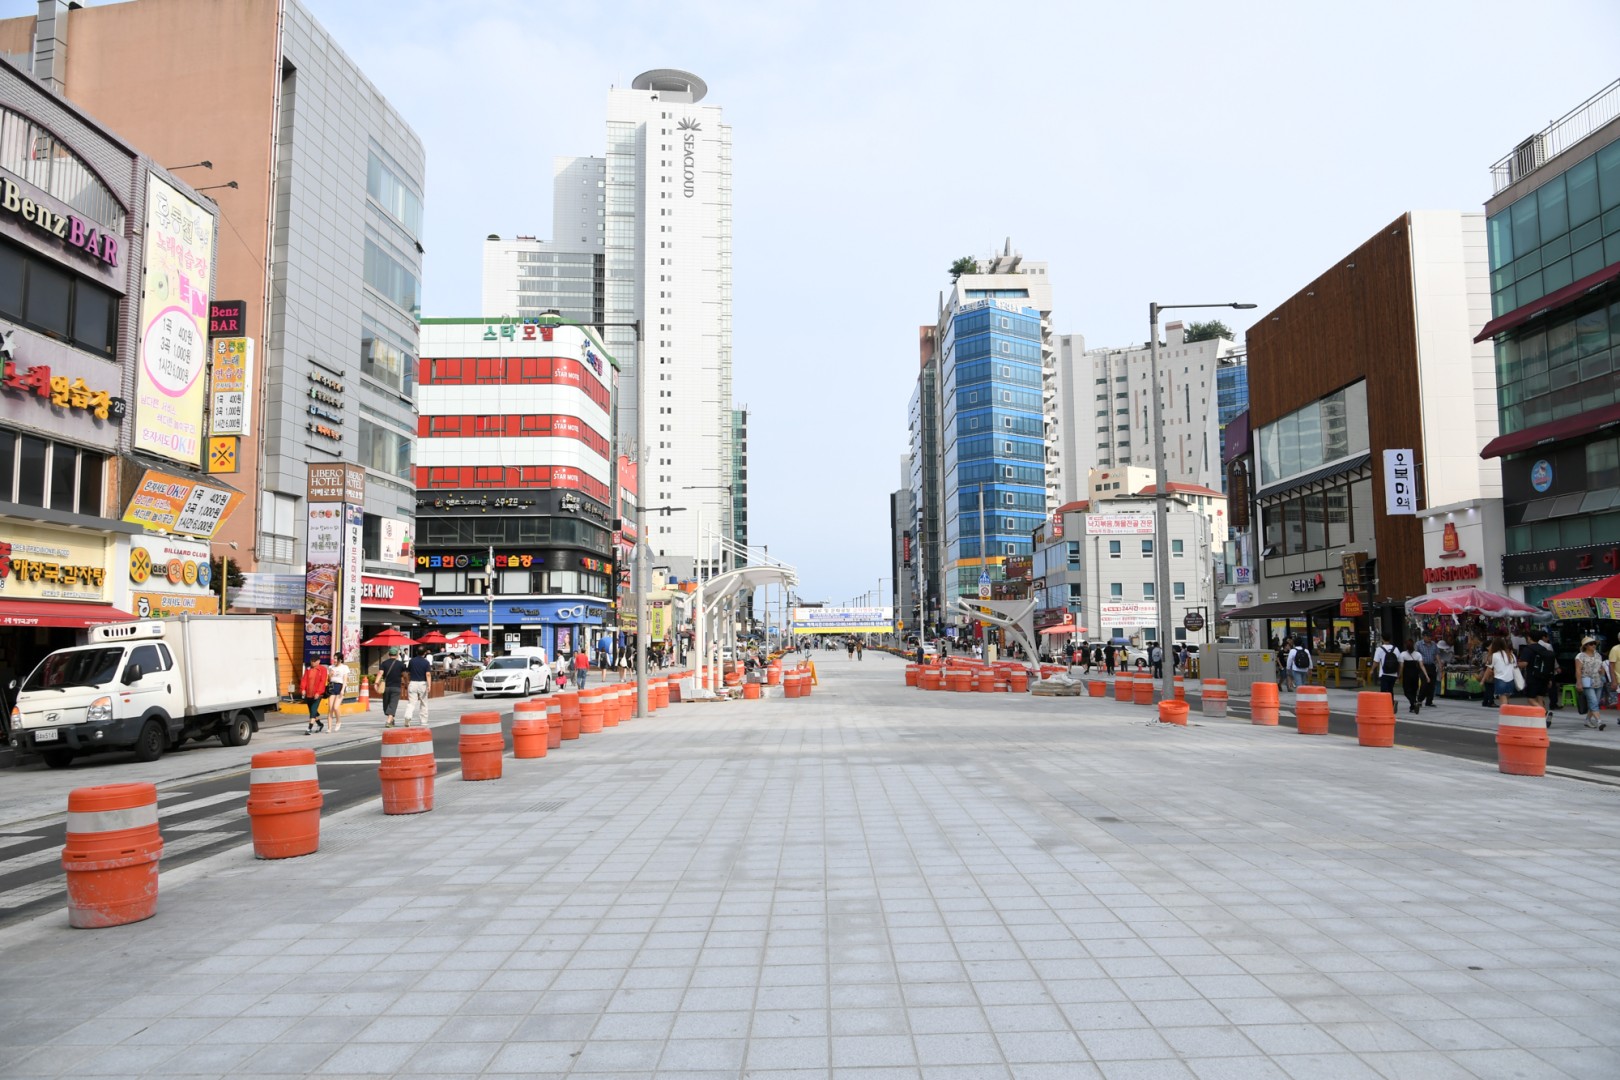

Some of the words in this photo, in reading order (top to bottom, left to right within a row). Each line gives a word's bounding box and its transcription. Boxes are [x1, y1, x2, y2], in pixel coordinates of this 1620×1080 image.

[683, 133, 695, 199] SEACLOUD
[1, 178, 67, 238] Benz
[67, 215, 118, 267] BAR
[210, 306, 239, 317] Benz
[163, 317, 173, 334] 1곡
[210, 320, 238, 332] BAR
[484, 324, 516, 342] 스타
[160, 336, 171, 354] 3곡
[215, 367, 243, 380] 연습장
[554, 370, 567, 378] STAR
[216, 394, 224, 404] 1곡
[229, 394, 242, 404] 400원
[114, 400, 126, 414] 2F
[311, 468, 344, 478] LIBERO
[553, 473, 566, 481] STAR
[311, 477, 343, 487] HOTEL
[193, 489, 205, 502] 1곡
[209, 493, 229, 506] 400원
[185, 502, 198, 515] 3곡
[199, 504, 221, 519] 1,000원
[164, 547, 192, 557] BILLIARD
[191, 551, 208, 559] CLUB
[1236, 567, 1250, 577] BR
[1447, 564, 1477, 582] TOUCH
[375, 583, 395, 599] KING
[420, 607, 464, 617] DAVICH
[1063, 613, 1073, 625] P
